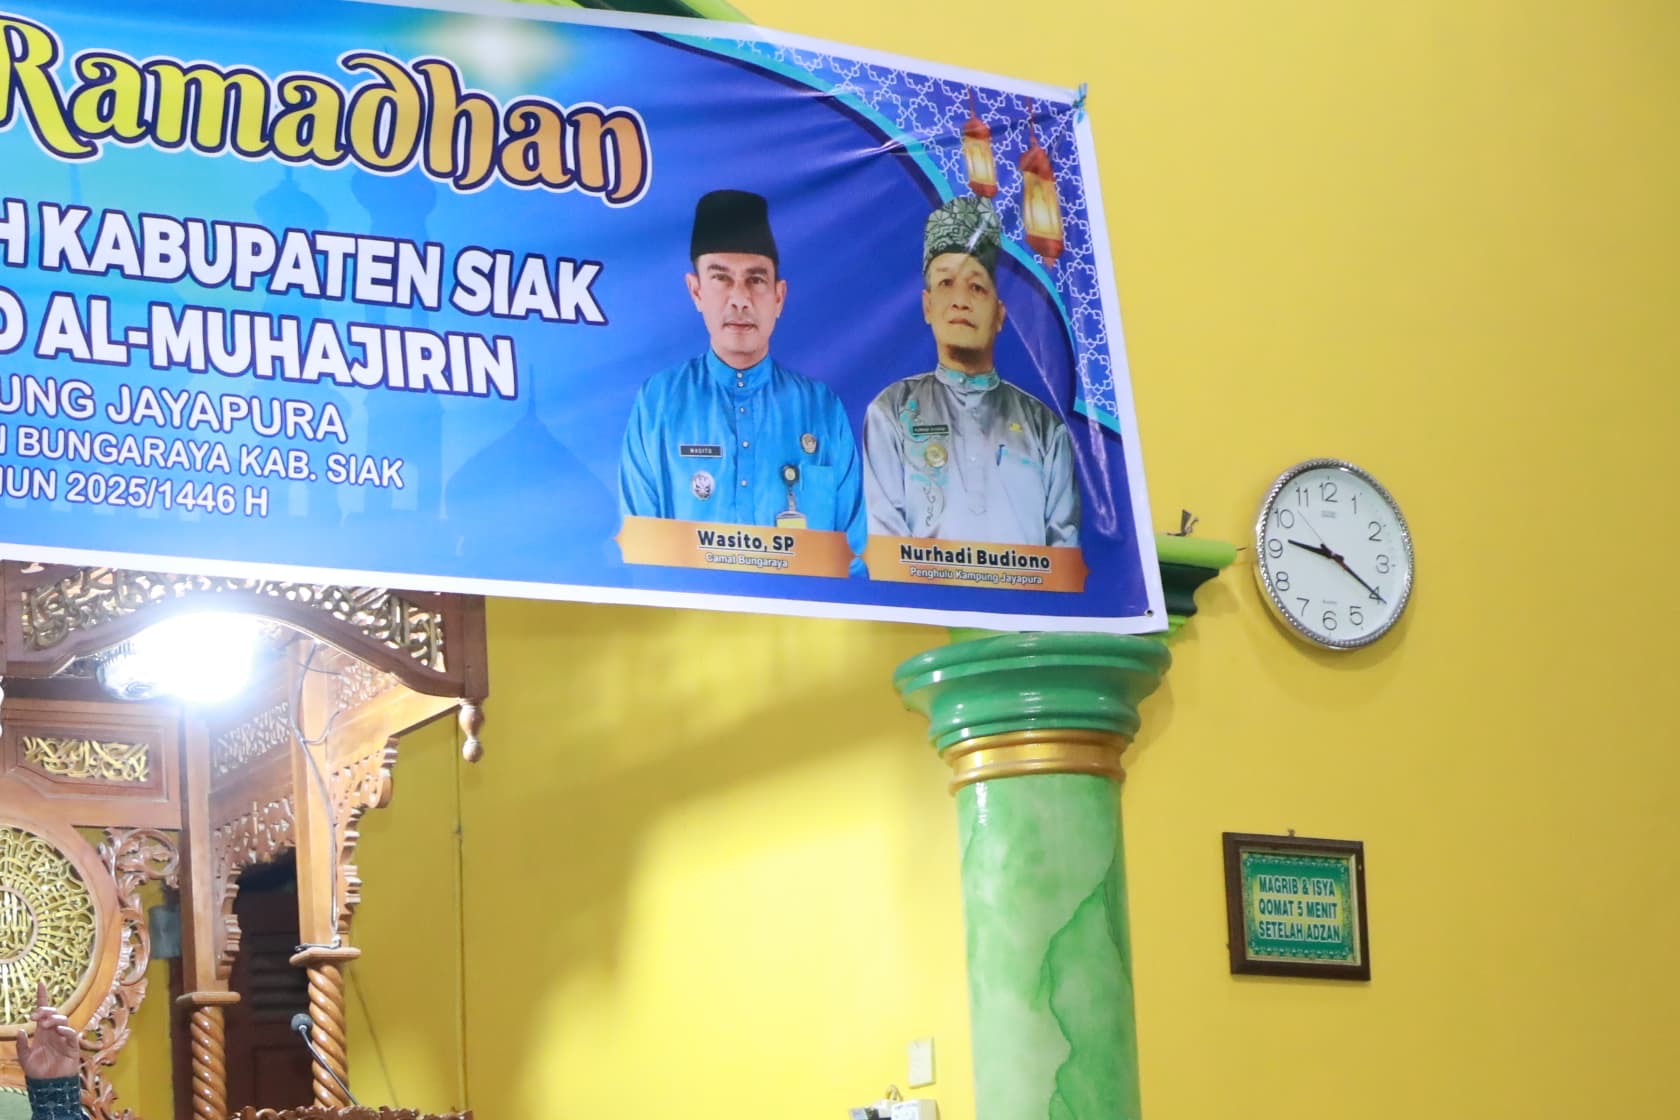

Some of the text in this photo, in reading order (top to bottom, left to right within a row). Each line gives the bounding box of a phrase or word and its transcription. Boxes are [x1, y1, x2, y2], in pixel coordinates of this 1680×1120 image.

[38, 203, 442, 311] KABUPATEN
[452, 248, 609, 327] SIAK
[36, 291, 518, 399] AL-MUHAJIRIN
[108, 384, 347, 443] JAYAPURA
[17, 431, 231, 474] BUNGARAYA
[239, 446, 317, 482] KAB.
[326, 453, 405, 489] SIAK
[65, 471, 235, 516] 2025/1446
[244, 486, 269, 517] H
[1296, 486, 1309, 507] 11
[1319, 482, 1339, 503] 12
[1273, 507, 1295, 529] 10
[697, 529, 795, 553] Wasito, SP
[1368, 521, 1383, 542] 2
[900, 544, 1051, 569] Nurhadi Budiono
[1268, 538, 1283, 559] 9
[706, 552, 789, 569] Camat Bungaraya
[1376, 554, 1390, 574] 3
[910, 566, 1043, 586] Penghulu Kampung Jayapura
[1275, 571, 1290, 591] 8
[1369, 586, 1381, 605] 4
[1296, 597, 1310, 616] 7
[1349, 606, 1364, 626] 5
[1322, 611, 1338, 631] 6
[1258, 875, 1335, 897] MAGRIB & ISYA
[1258, 898, 1337, 919] QOMAT 5 MENIT
[1259, 921, 1341, 943] SETELAH ADZAN
